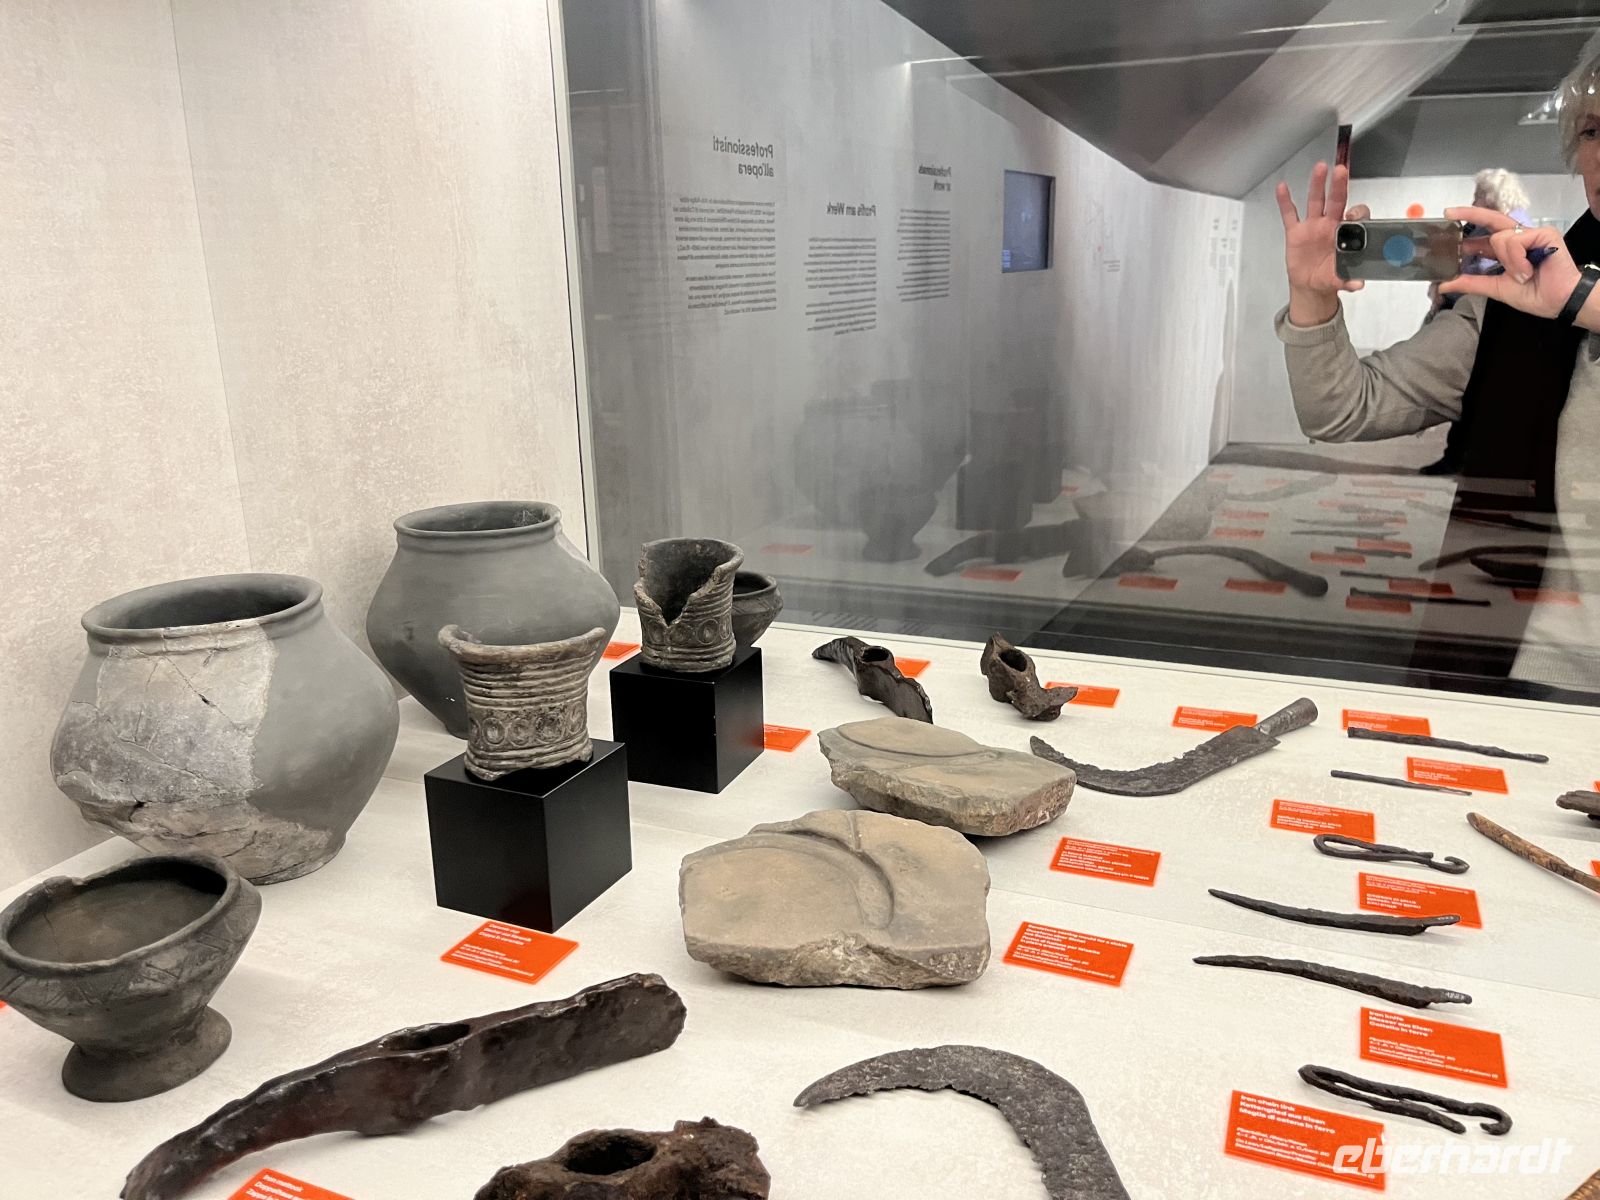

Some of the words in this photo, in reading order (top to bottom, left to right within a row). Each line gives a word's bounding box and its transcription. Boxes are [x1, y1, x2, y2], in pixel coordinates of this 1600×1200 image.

[1240, 1102, 1287, 1117] Kettenglied
[1302, 1116, 1326, 1125] Eisen
[1241, 1095, 1257, 1103] Iron
[1257, 1100, 1280, 1108] chain
[1280, 1104, 1296, 1112] link
